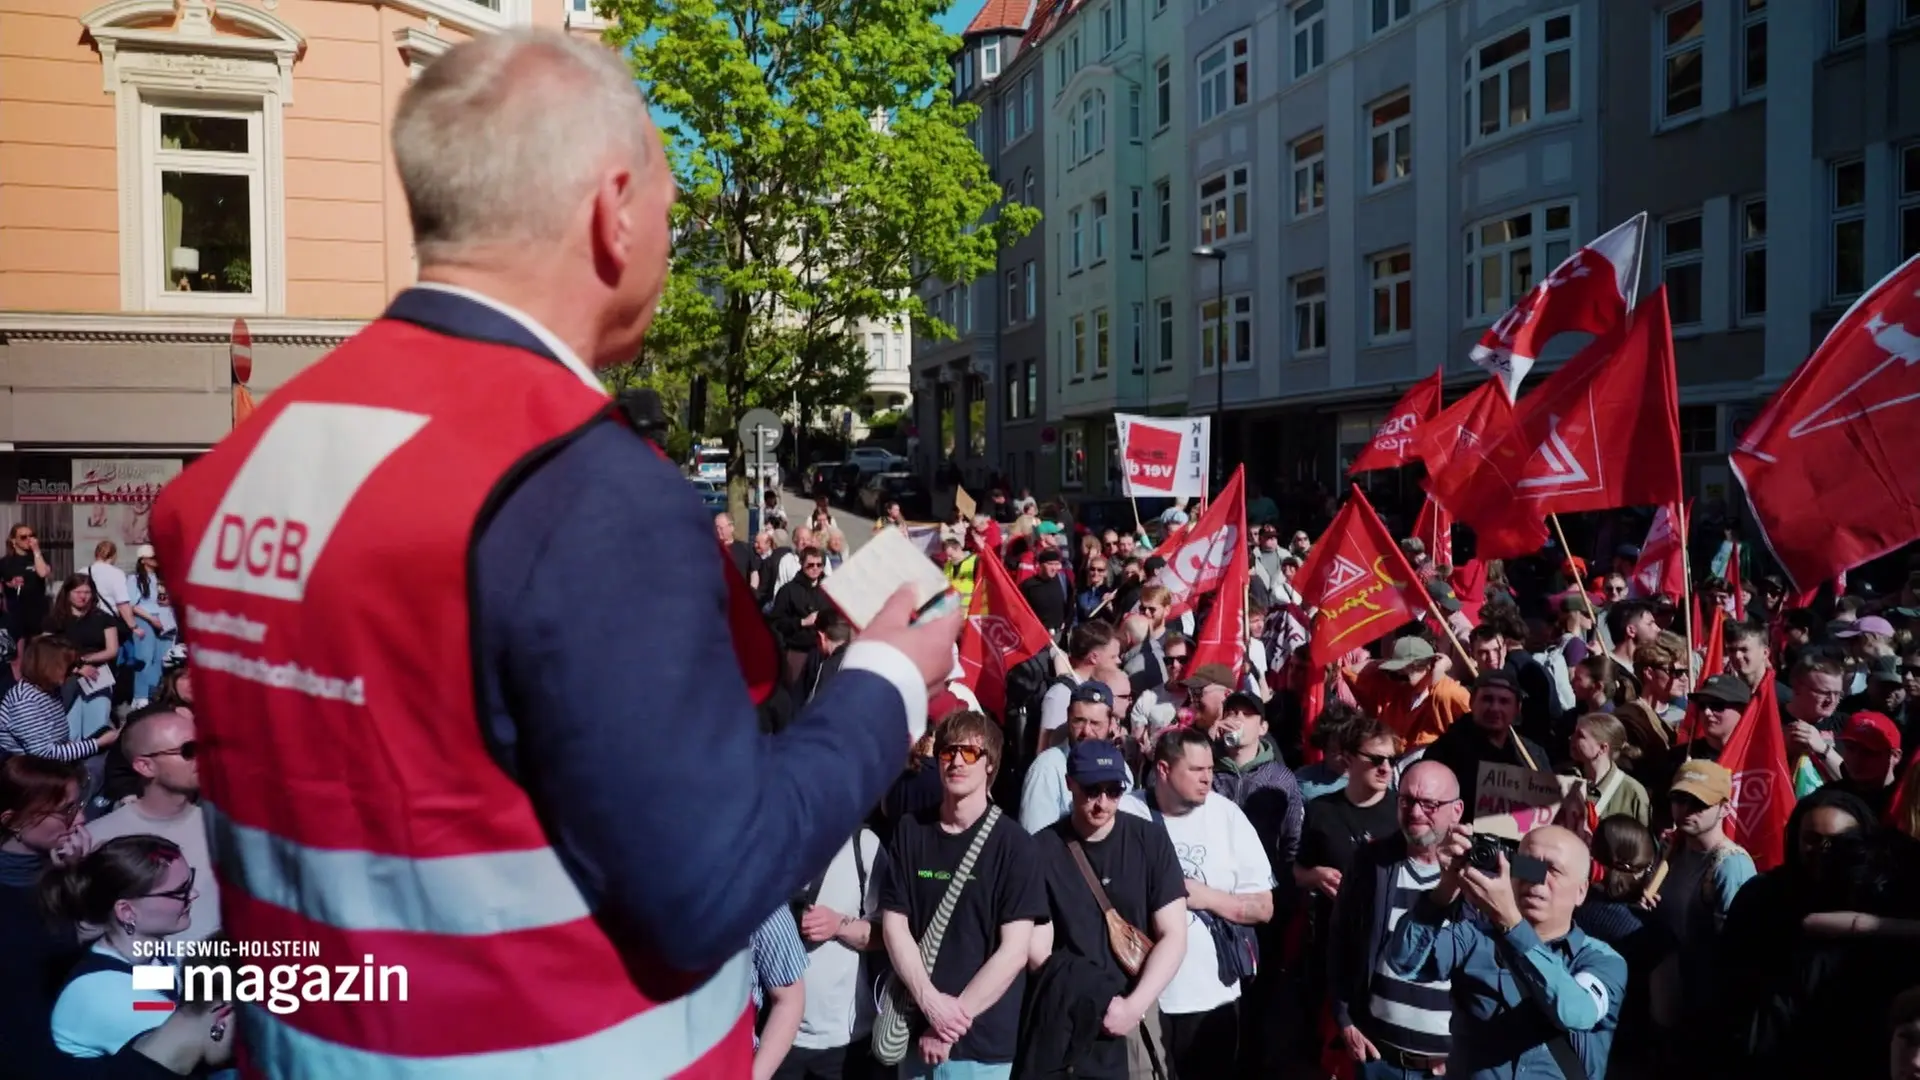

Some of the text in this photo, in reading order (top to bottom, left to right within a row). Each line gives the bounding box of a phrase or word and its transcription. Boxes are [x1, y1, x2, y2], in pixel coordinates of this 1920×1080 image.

[17, 478, 71, 494] Salon
[213, 513, 309, 580] DGB
[1483, 769, 1520, 790] Alles
